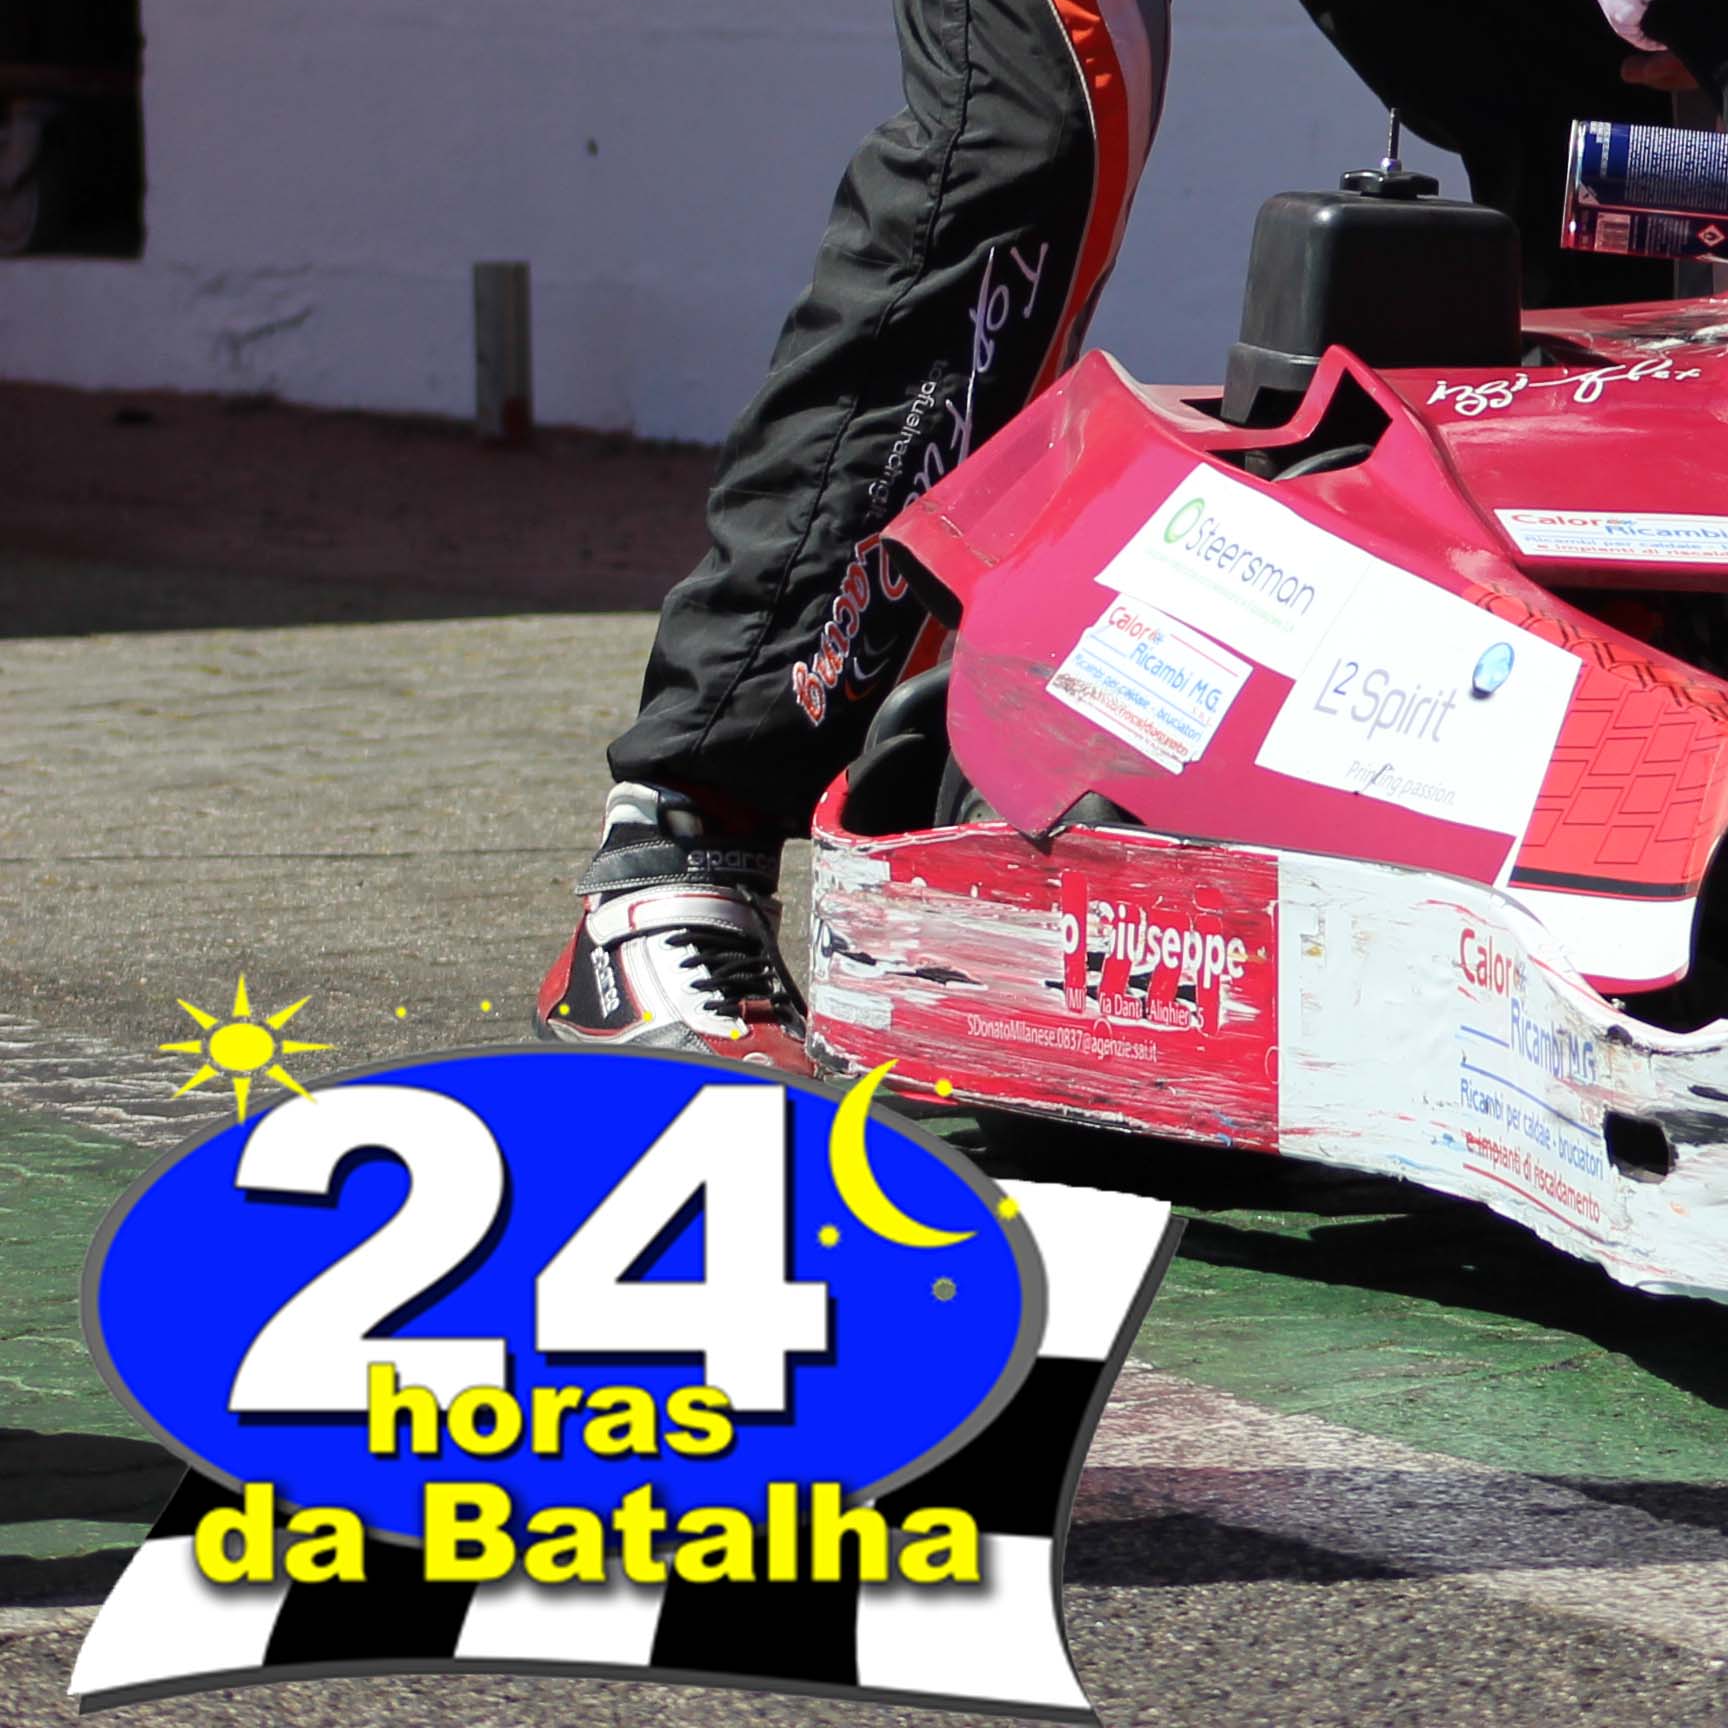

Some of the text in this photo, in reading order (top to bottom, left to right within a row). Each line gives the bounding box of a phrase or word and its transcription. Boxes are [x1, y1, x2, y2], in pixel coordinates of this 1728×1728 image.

[1510, 513, 1601, 528] Calor
[1604, 524, 1728, 540] Ricambi
[1184, 516, 1316, 617] Steersman
[1107, 606, 1152, 640] Calor
[1129, 642, 1191, 693] Ricambi
[1350, 668, 1457, 743] Spirit
[1458, 928, 1514, 998] Calor
[1113, 994, 1143, 1020] Dant
[1149, 1003, 1191, 1028] Alighier
[1510, 997, 1564, 1081] Ricambi
[1460, 1077, 1504, 1122] Ricambi
[1505, 1101, 1522, 1133] per
